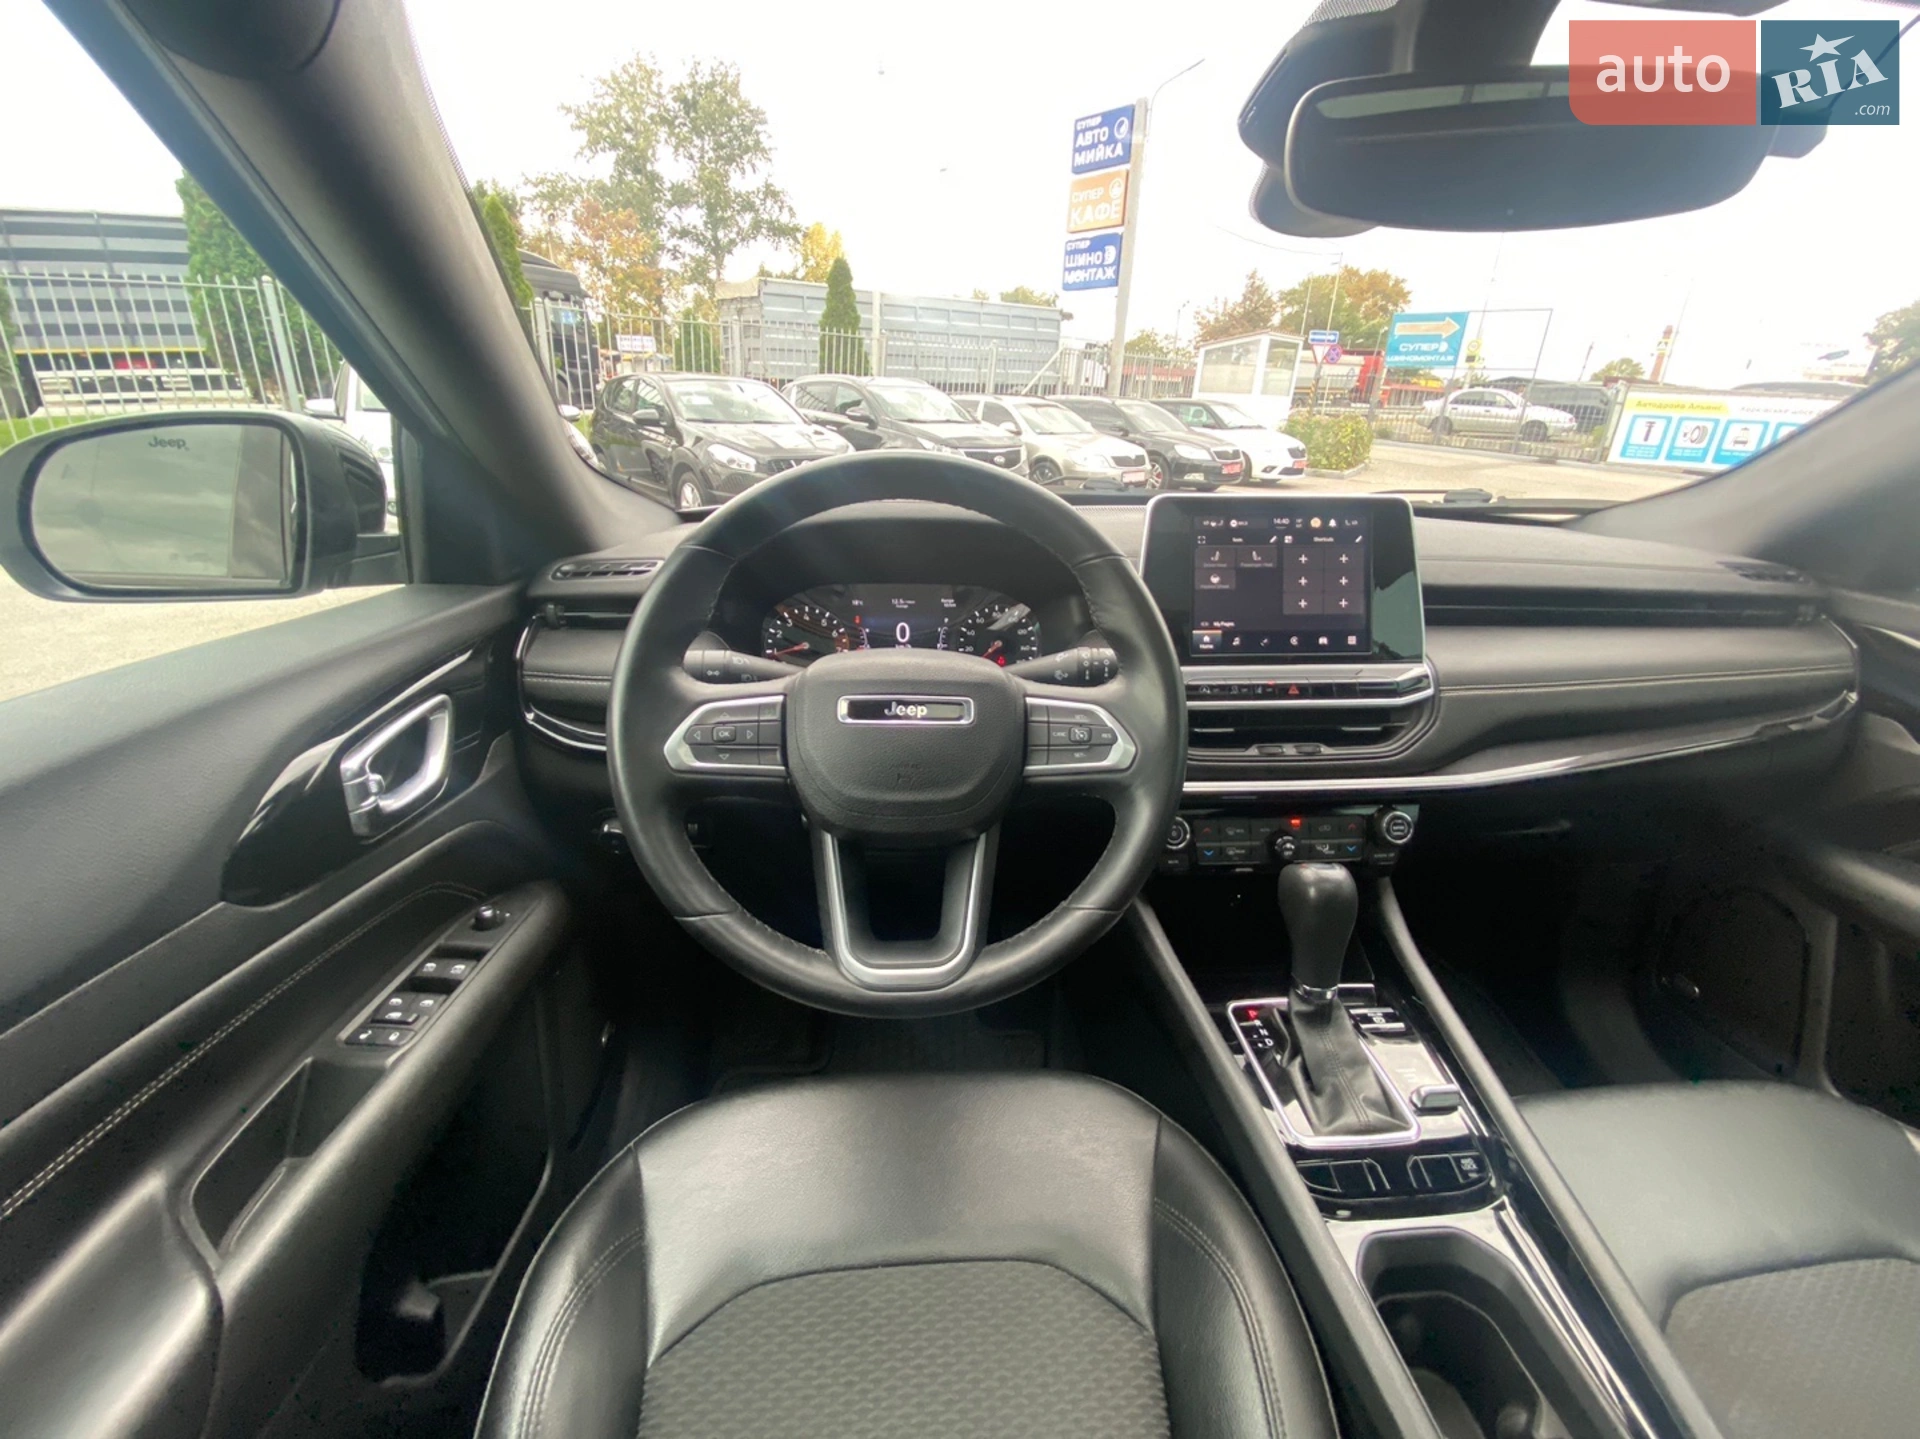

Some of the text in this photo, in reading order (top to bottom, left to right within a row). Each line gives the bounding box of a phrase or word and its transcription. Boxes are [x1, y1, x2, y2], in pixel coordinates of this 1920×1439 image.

[1075, 126, 1109, 148] АВТО
[1074, 141, 1124, 167] МИЙКА
[1069, 201, 1121, 227] КАФЕ
[1065, 251, 1103, 268] ШИНО
[1063, 265, 1116, 284] МОНТАЖ
[1399, 342, 1439, 352] СУПЕР
[148, 435, 186, 450] Jeep
[776, 630, 783, 638] 2
[832, 630, 838, 638] 6
[896, 622, 910, 643] 0
[884, 701, 928, 719] Jeep
[1264, 1038, 1274, 1047] D
